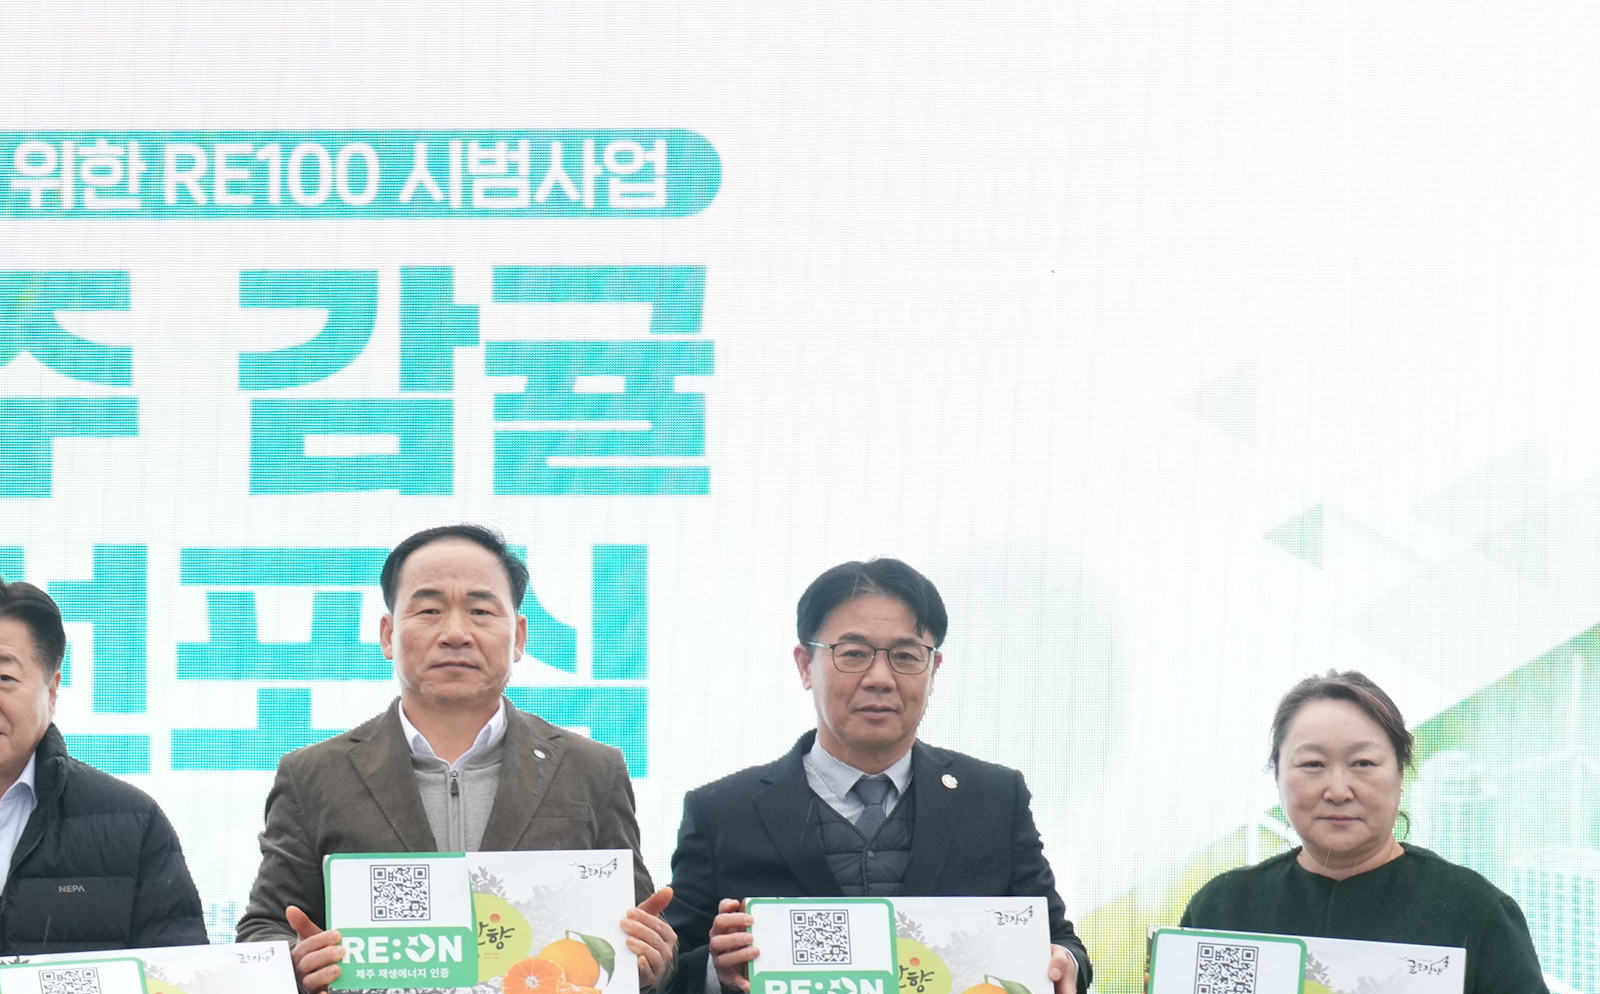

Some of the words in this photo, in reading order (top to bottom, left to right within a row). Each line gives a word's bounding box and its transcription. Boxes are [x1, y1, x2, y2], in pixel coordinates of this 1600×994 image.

[13, 139, 149, 212] 위한
[163, 141, 381, 208] RE100
[399, 138, 668, 211] 시범사업
[238, 264, 717, 497] 감귤
[58, 884, 86, 893] NEPA
[344, 934, 462, 963] RE:ON
[355, 968, 376, 980] 제주
[378, 968, 427, 980] 재생에너지
[429, 967, 450, 979] 인증
